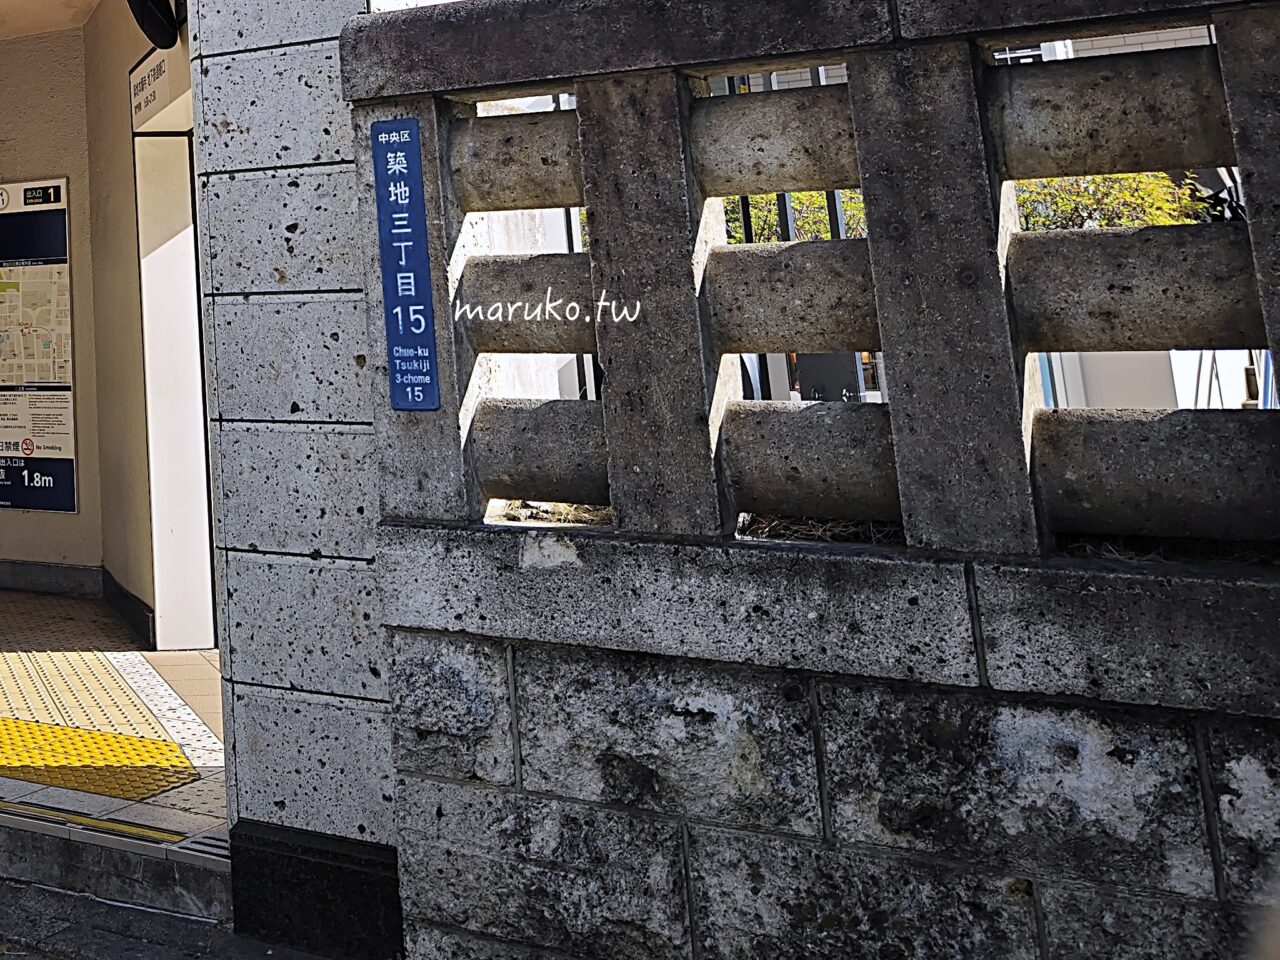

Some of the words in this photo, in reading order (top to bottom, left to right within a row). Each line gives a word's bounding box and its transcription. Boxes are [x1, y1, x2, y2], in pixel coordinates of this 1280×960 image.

[379, 131, 411, 144] 中央区
[26, 190, 42, 198] 出入口
[48, 187, 55, 202] 1
[386, 152, 415, 297] 築地三丁目
[392, 305, 426, 335] 15
[393, 346, 429, 357] Chuo-ku
[395, 359, 430, 373] Tsukiji
[395, 373, 431, 384] 3-chome
[406, 387, 424, 402] 15
[22, 469, 53, 488] 1.8m
